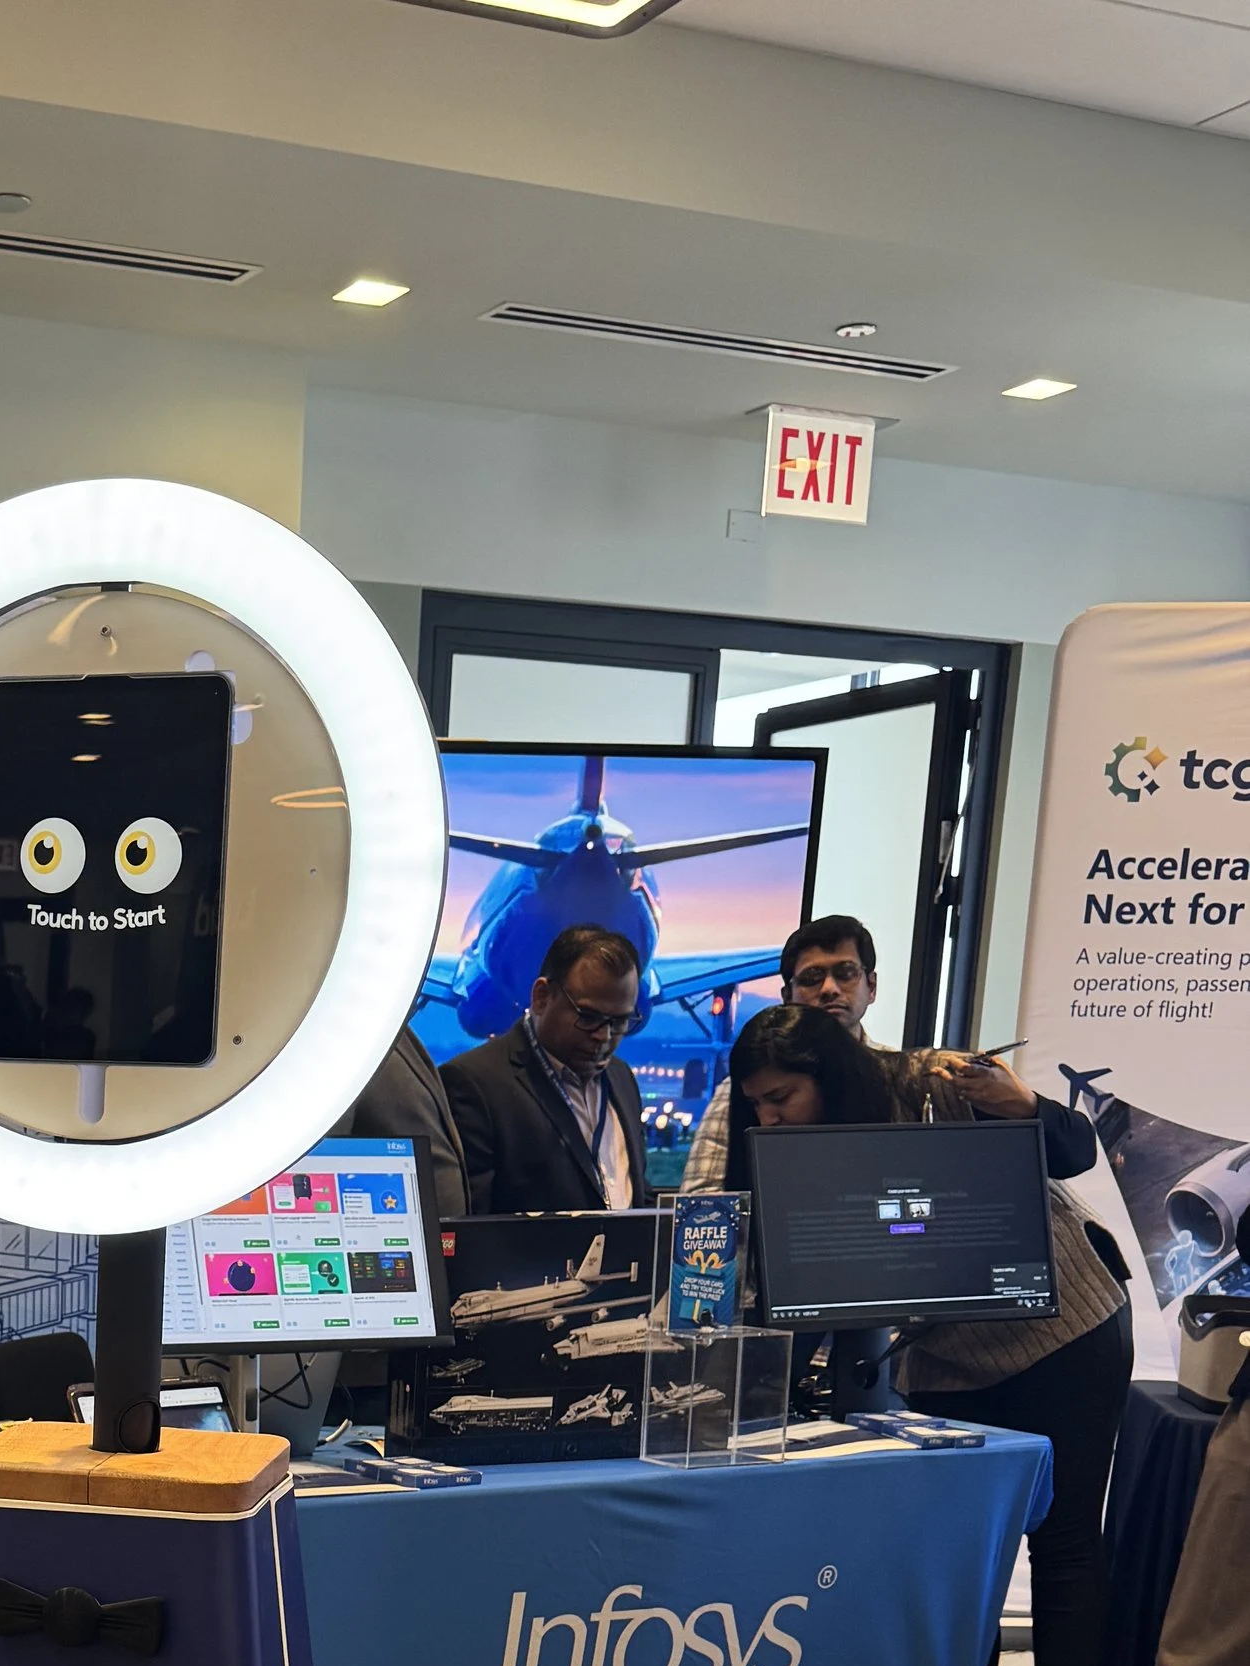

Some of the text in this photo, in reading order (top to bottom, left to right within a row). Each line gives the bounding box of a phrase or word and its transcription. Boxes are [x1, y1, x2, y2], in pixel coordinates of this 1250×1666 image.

[777, 427, 862, 505] EXIT
[1087, 847, 1250, 881] Accelera
[27, 903, 166, 931] Touch to Start
[1082, 892, 1245, 926] Next for
[1075, 948, 1090, 965] A
[1097, 947, 1232, 971] value-creating
[1073, 974, 1179, 996] operations,
[1070, 999, 1214, 1023] future of flight!
[683, 1240, 728, 1250] GIVEAWAY
[684, 1226, 728, 1240] RAFFLE
